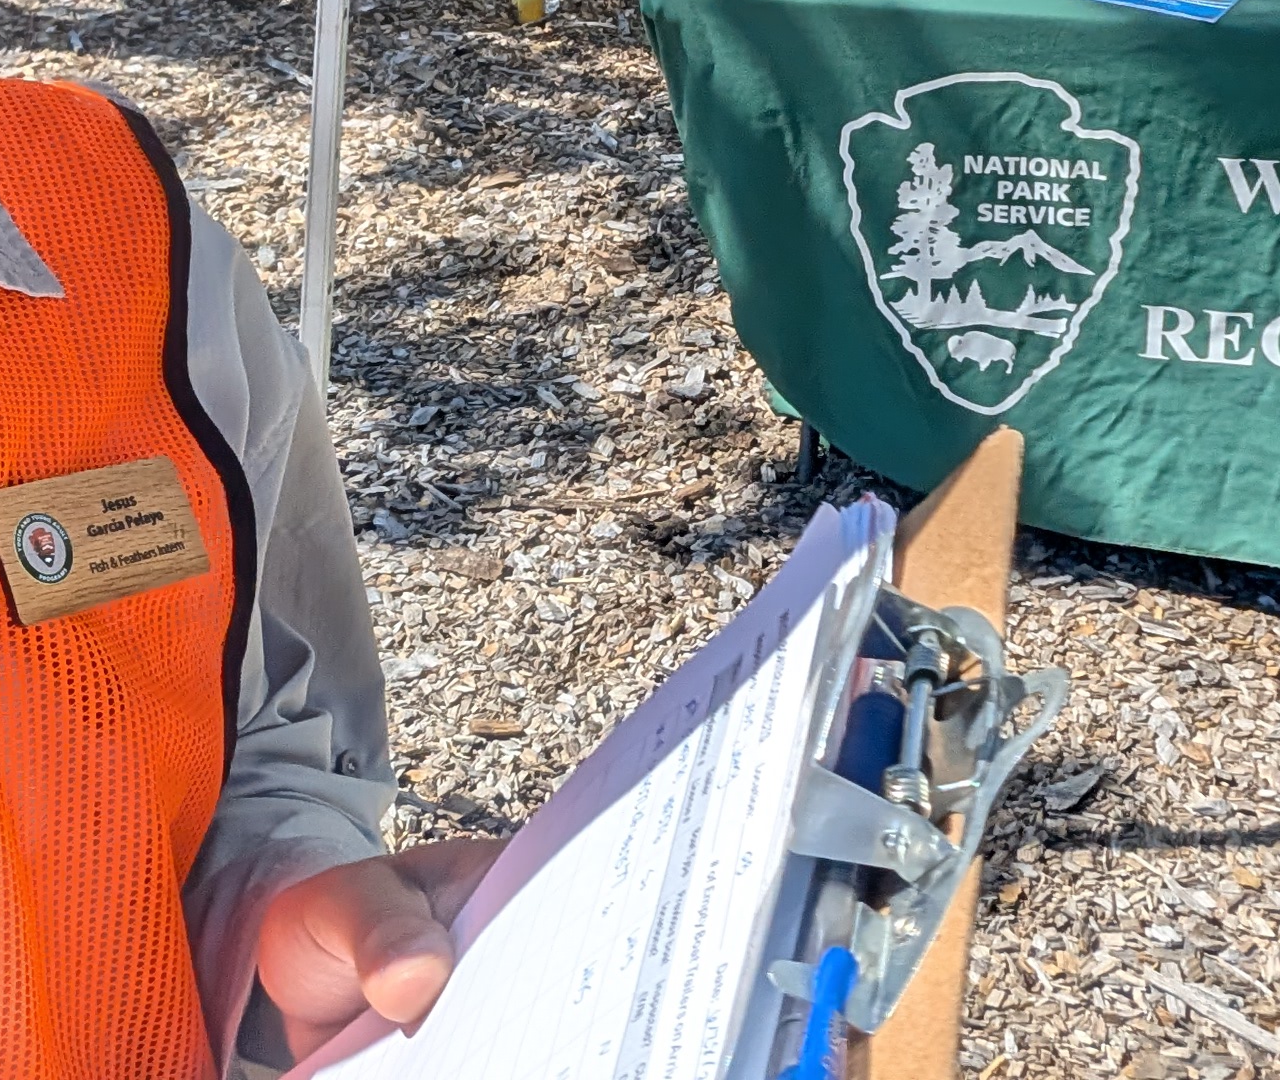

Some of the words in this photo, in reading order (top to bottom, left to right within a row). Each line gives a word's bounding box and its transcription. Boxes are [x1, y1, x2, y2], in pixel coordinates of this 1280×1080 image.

[964, 155, 1107, 181] NATIONAL
[997, 181, 1071, 203] PARK
[977, 204, 1091, 227] SERVICE
[101, 496, 138, 513] Jesus
[124, 511, 165, 529] Pelayo
[89, 559, 111, 574] Fish
[109, 556, 120, 569] &
[117, 550, 159, 567] Feathers
[156, 541, 187, 557] Intern
[676, 961, 698, 1021] Trailers
